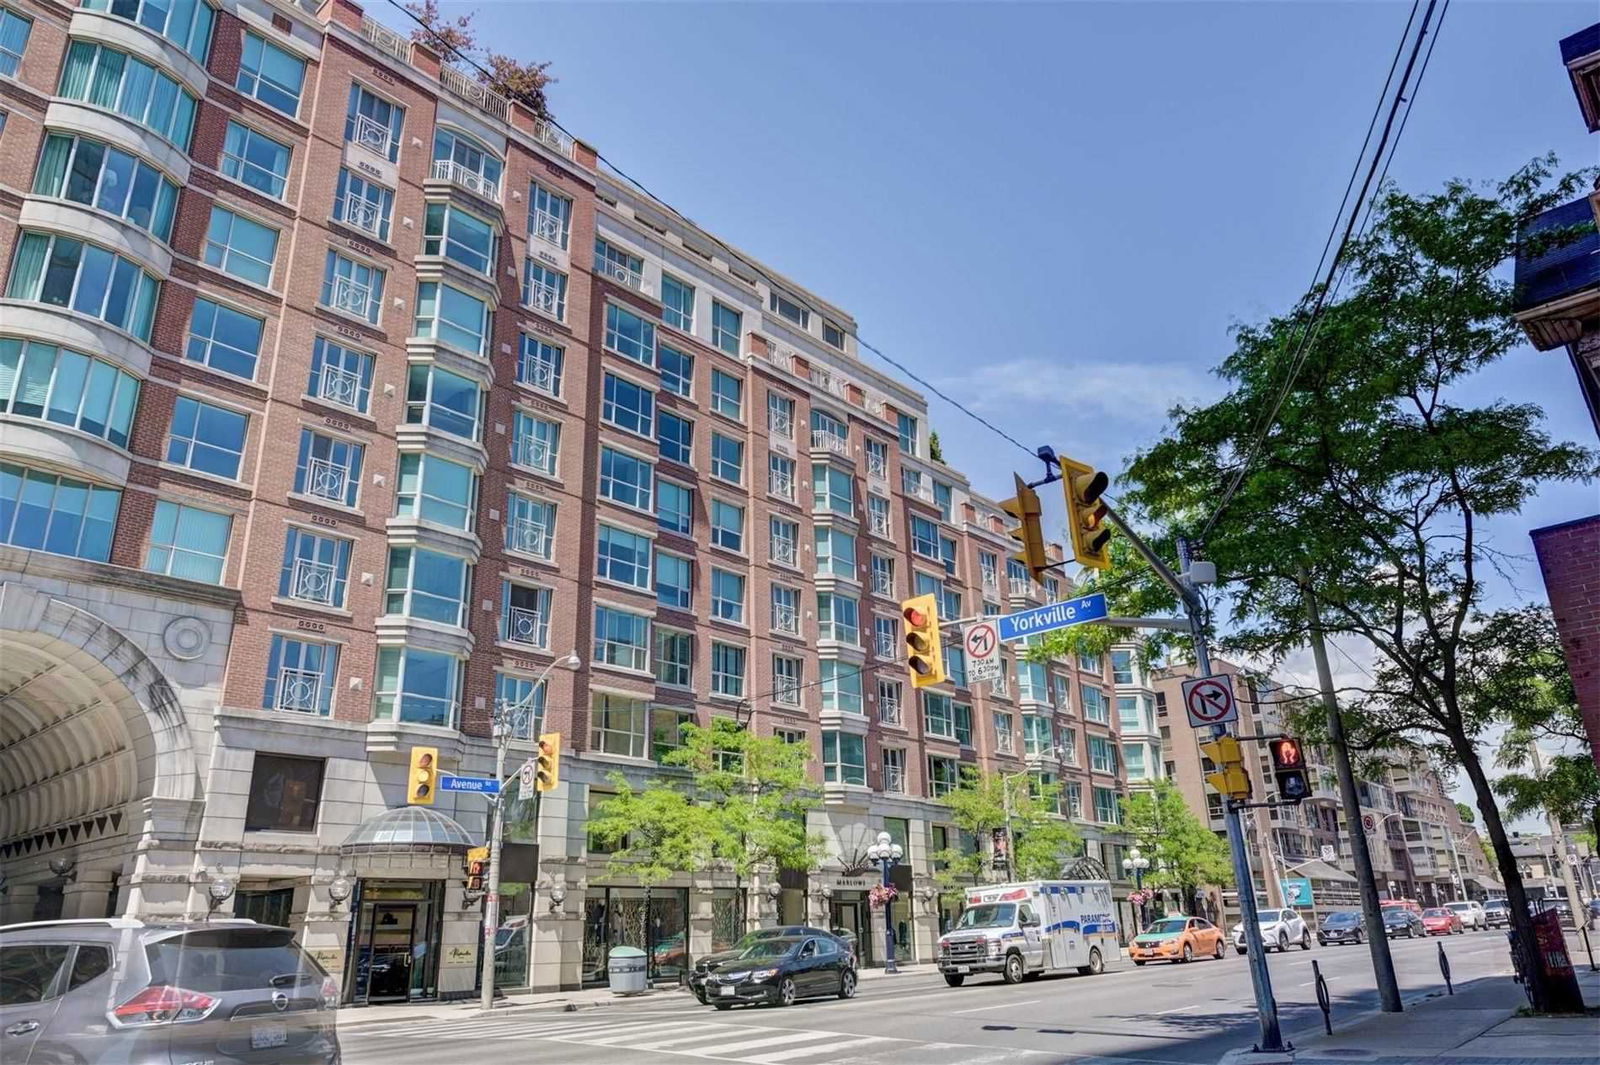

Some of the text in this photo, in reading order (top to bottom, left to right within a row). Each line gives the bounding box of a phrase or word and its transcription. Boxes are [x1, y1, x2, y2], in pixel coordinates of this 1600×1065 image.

[1010, 600, 1092, 633] Yorkville Av
[450, 778, 483, 791] Avenue
